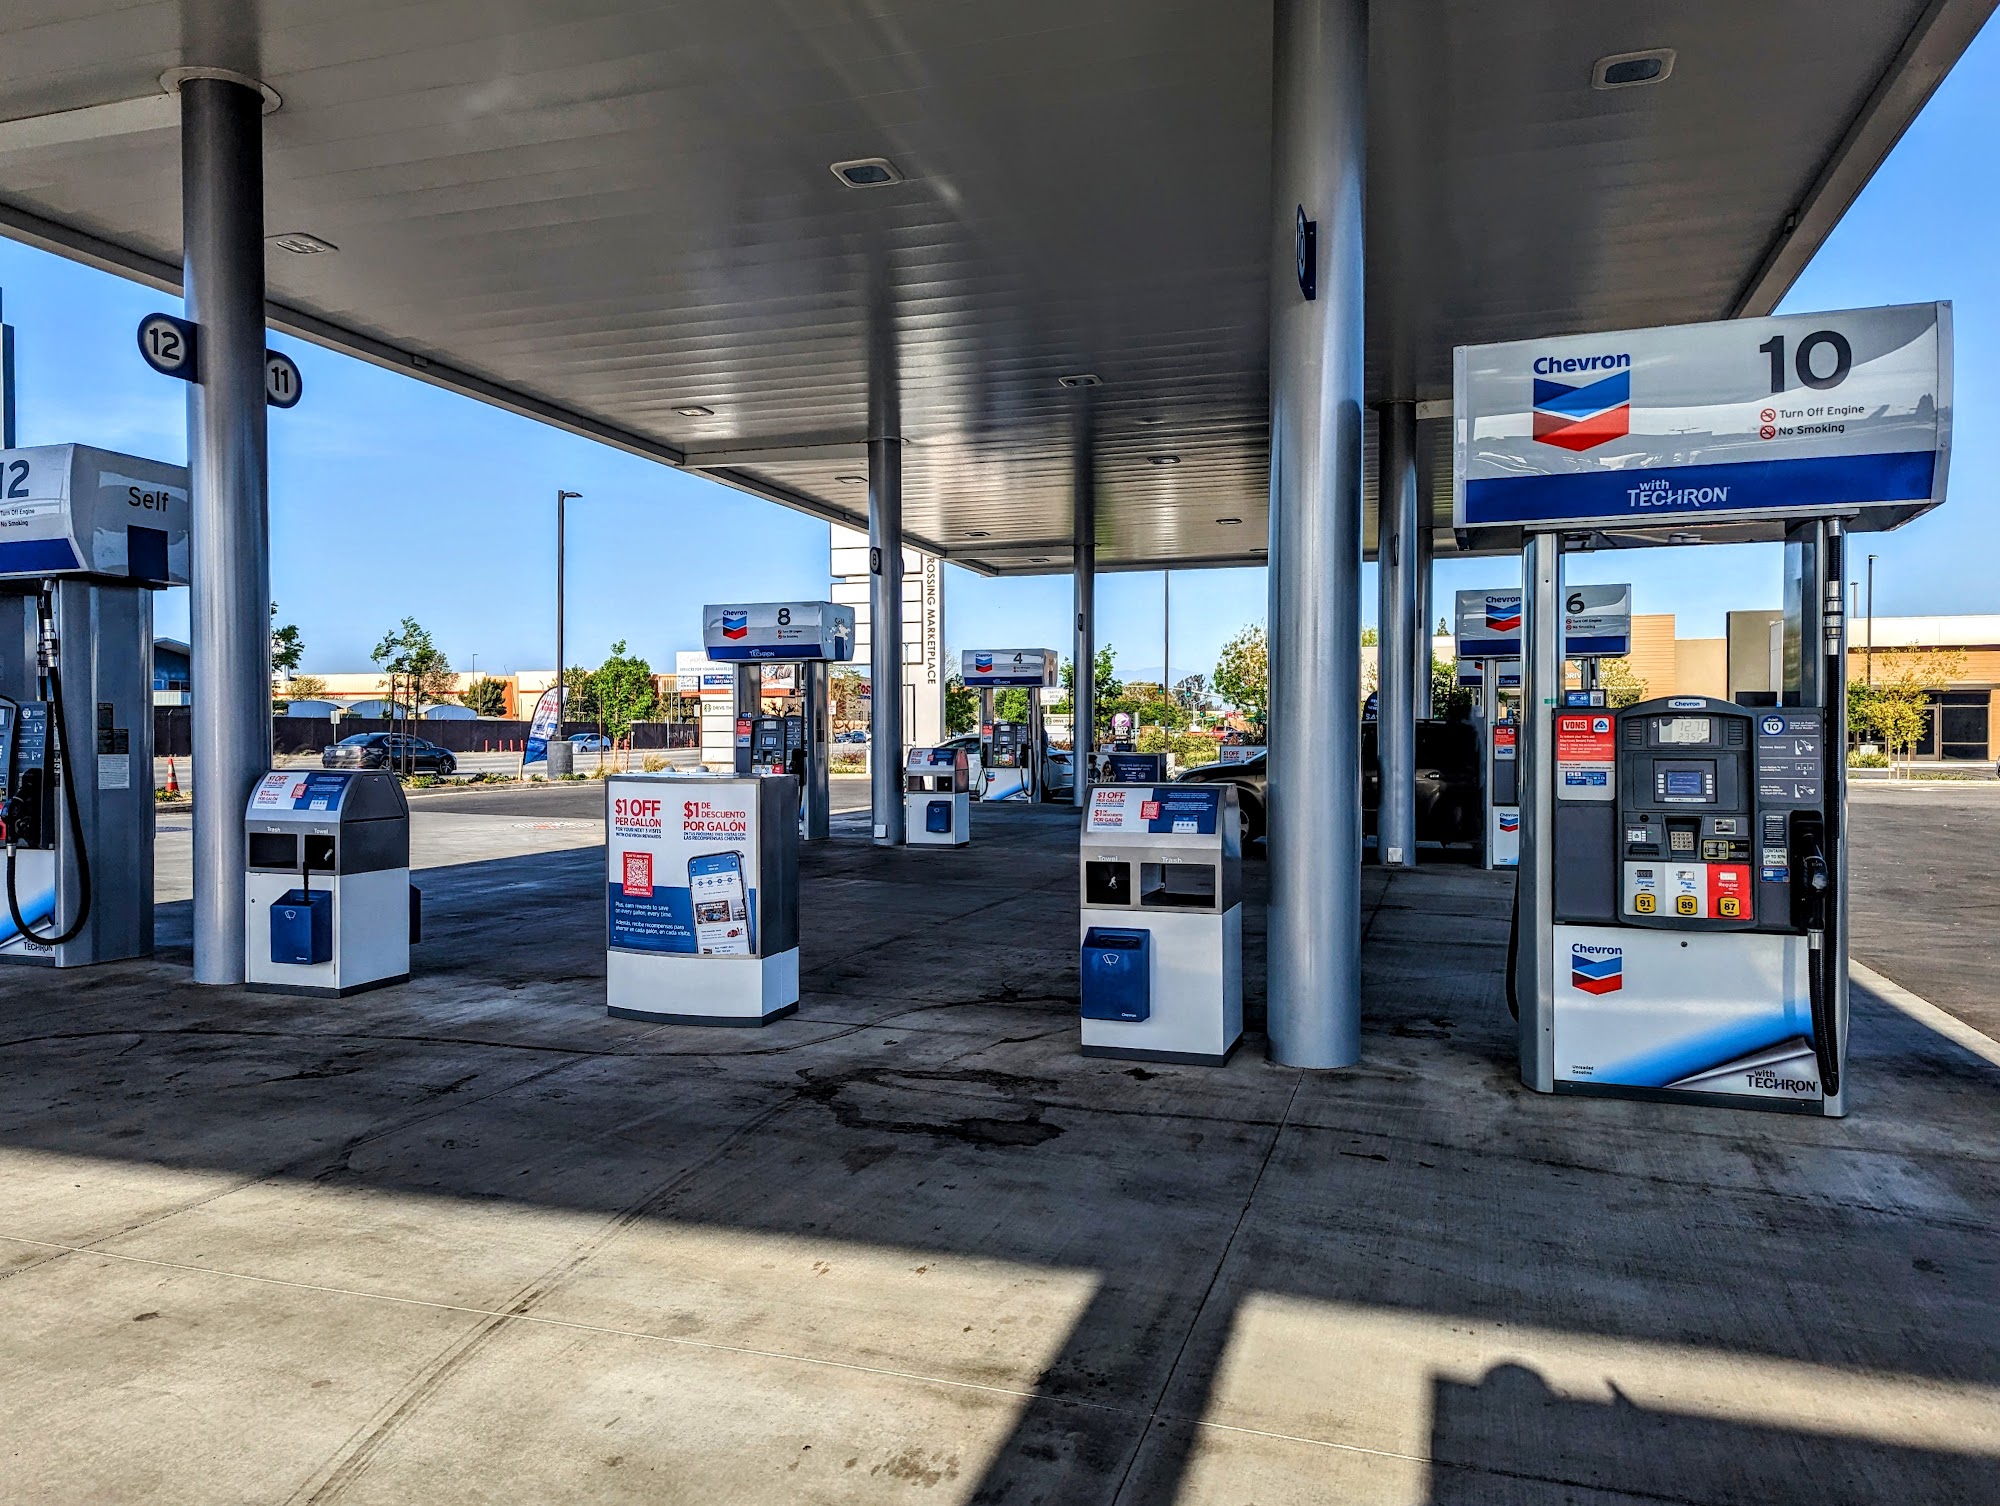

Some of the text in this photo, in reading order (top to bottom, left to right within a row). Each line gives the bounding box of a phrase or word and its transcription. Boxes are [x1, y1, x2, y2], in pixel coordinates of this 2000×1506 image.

[149, 328, 180, 360] 12
[1533, 353, 1630, 375] Chevron
[1759, 330, 1852, 393] 10
[271, 366, 289, 393] 11
[1780, 405, 1865, 419] Turn Off Engine
[1778, 423, 1845, 436] No Smoking
[1639, 479, 1670, 490] with
[128, 486, 170, 512] Self
[1627, 487, 1728, 507] TECHRON
[1566, 592, 1585, 614] 6
[777, 607, 791, 625] 8
[926, 608, 936, 684] MARKETPLACE
[1013, 652, 1023, 664] 4
[1565, 721, 1586, 729] VONS
[1766, 723, 1779, 731] 10
[1107, 791, 1126, 799] OFF
[615, 798, 661, 817] $1 OFF
[683, 800, 699, 819] $1
[1094, 809, 1103, 817] $1
[615, 816, 662, 827] PER GALLON
[683, 819, 746, 831] POR GALÓN
[1639, 899, 1652, 907] 91
[1681, 901, 1693, 909] 89
[1724, 902, 1736, 911] 87
[1571, 943, 1623, 955] Chevron
[1754, 1069, 1775, 1078] with
[1746, 1074, 1816, 1093] TECHRON
